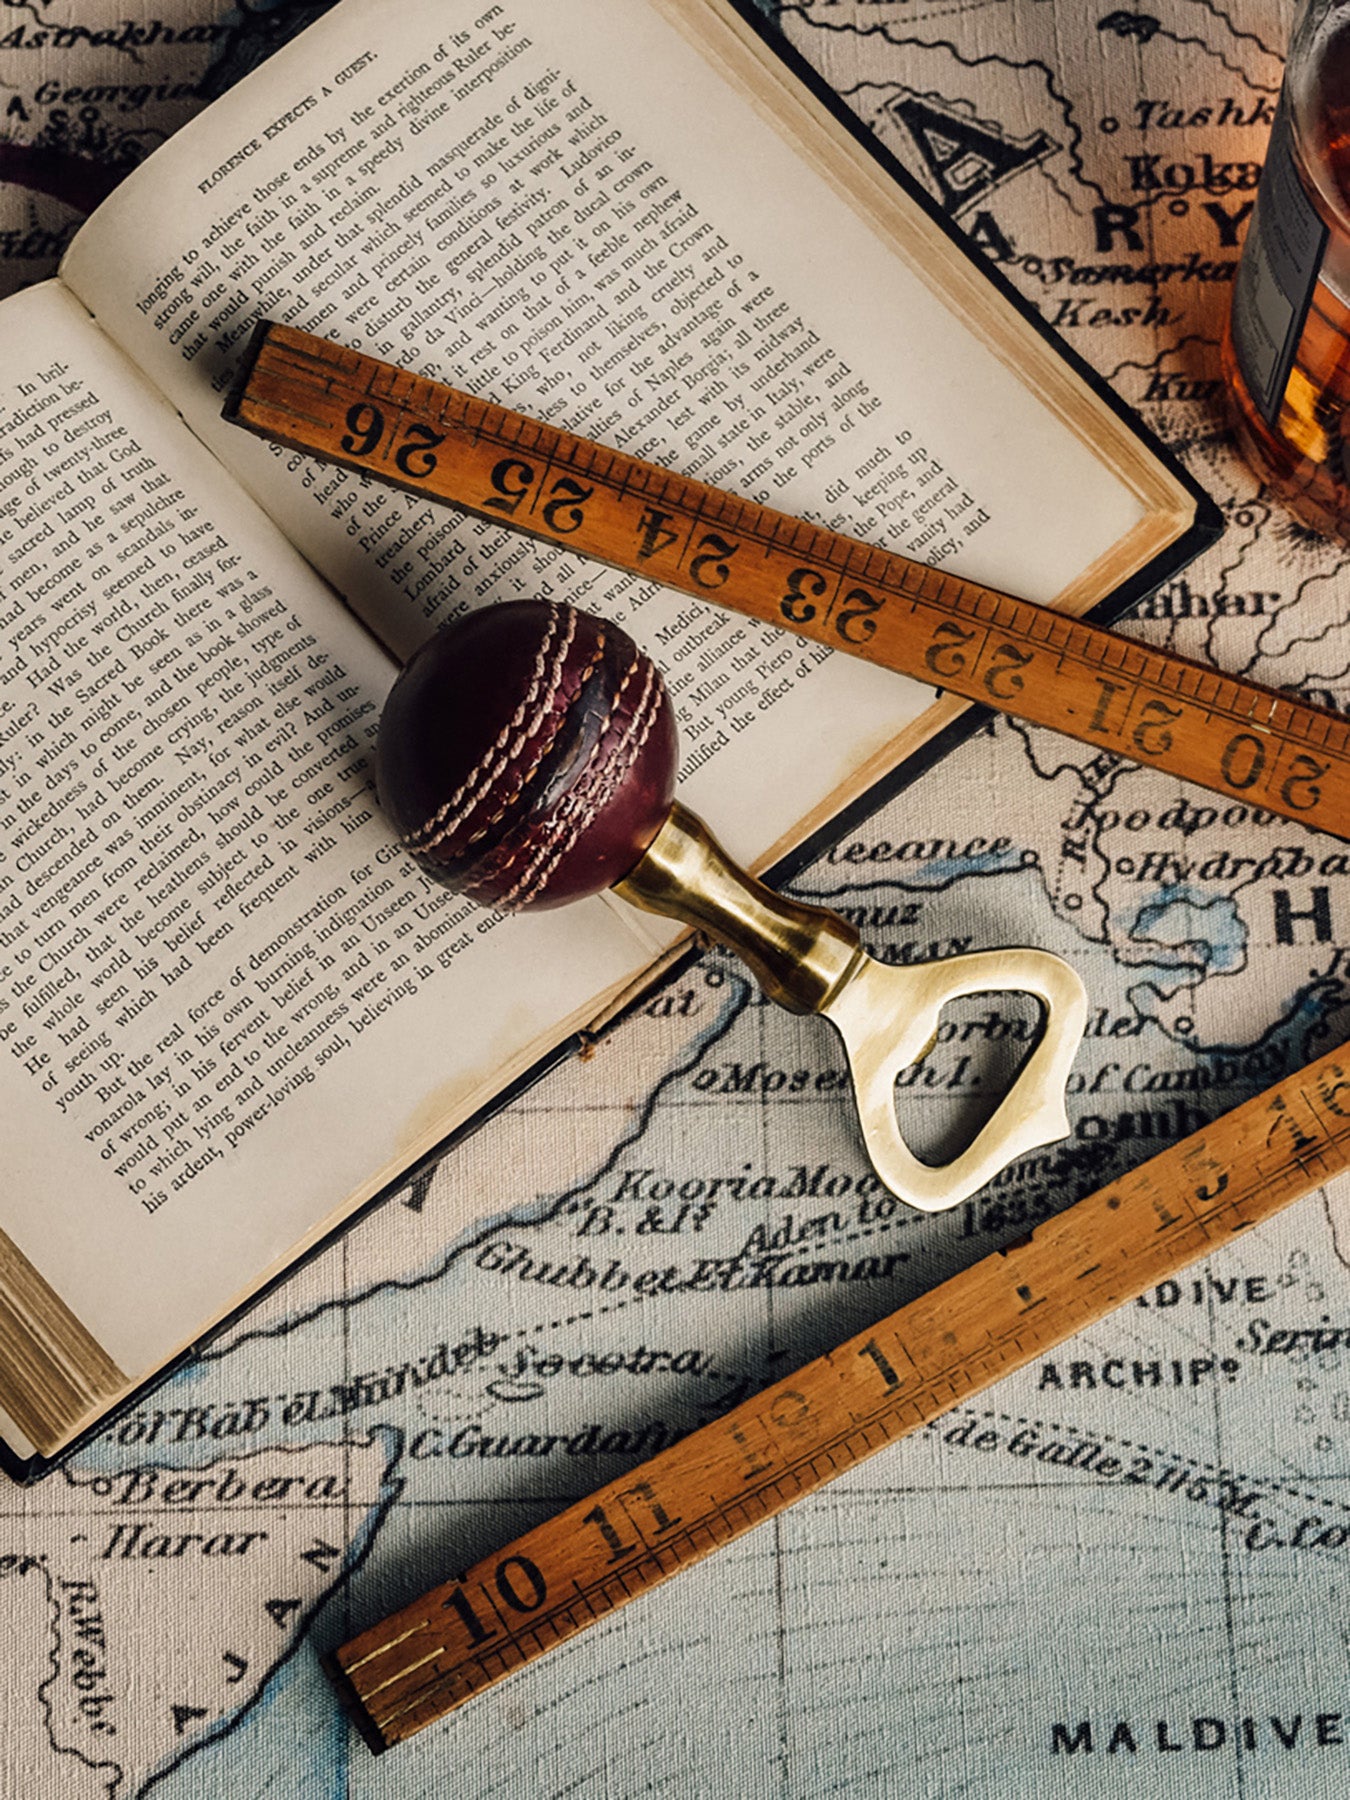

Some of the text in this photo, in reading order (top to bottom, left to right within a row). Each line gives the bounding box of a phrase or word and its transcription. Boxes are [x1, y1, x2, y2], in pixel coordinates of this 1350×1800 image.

[135, 4, 505, 316] longing to achieve those ends by the exertion of its own
[196, 50, 379, 195] FLORENCE EXPECTS A GUEST.
[291, 247, 334, 285] under
[333, 222, 366, 249] that
[365, 173, 424, 225] splendid
[425, 114, 505, 178] masquerade
[505, 94, 522, 115] of
[522, 69, 561, 101] digni-
[364, 129, 623, 338] disturb the general festivity. Ludovico
[500, 222, 715, 395] King Ferdinand and the Crown
[588, 254, 744, 381] themselves, objected to
[613, 301, 790, 449] Alexander Borgia; all three
[24, 426, 129, 496] of twenty-three
[341, 401, 447, 479] 26
[7, 456, 158, 565] sacred lamp of truth
[357, 510, 403, 554] Prince
[374, 508, 436, 570] treachery
[484, 457, 594, 533] 25
[402, 538, 468, 603] Lombard
[636, 503, 739, 589] 24
[25, 534, 230, 690] Had the world, then, ceased
[653, 605, 711, 647] Medici,
[672, 612, 731, 663] outbreak
[778, 568, 886, 646] 23
[683, 648, 794, 742] But young Piero
[687, 646, 762, 708] Milan that
[925, 620, 1037, 700] 22
[676, 645, 835, 785] nullified the effect of his
[10, 757, 370, 1059] the whole world become subject to the one true
[1272, 886, 1333, 945] H
[93, 863, 374, 1105] But the real force of demonstration for
[140, 931, 475, 1215] his ardent, power-loving soul, believing in great
[112, 1470, 342, 1506] Berbera
[101, 1523, 269, 1560] Harar
[442, 1554, 550, 1650] 10
